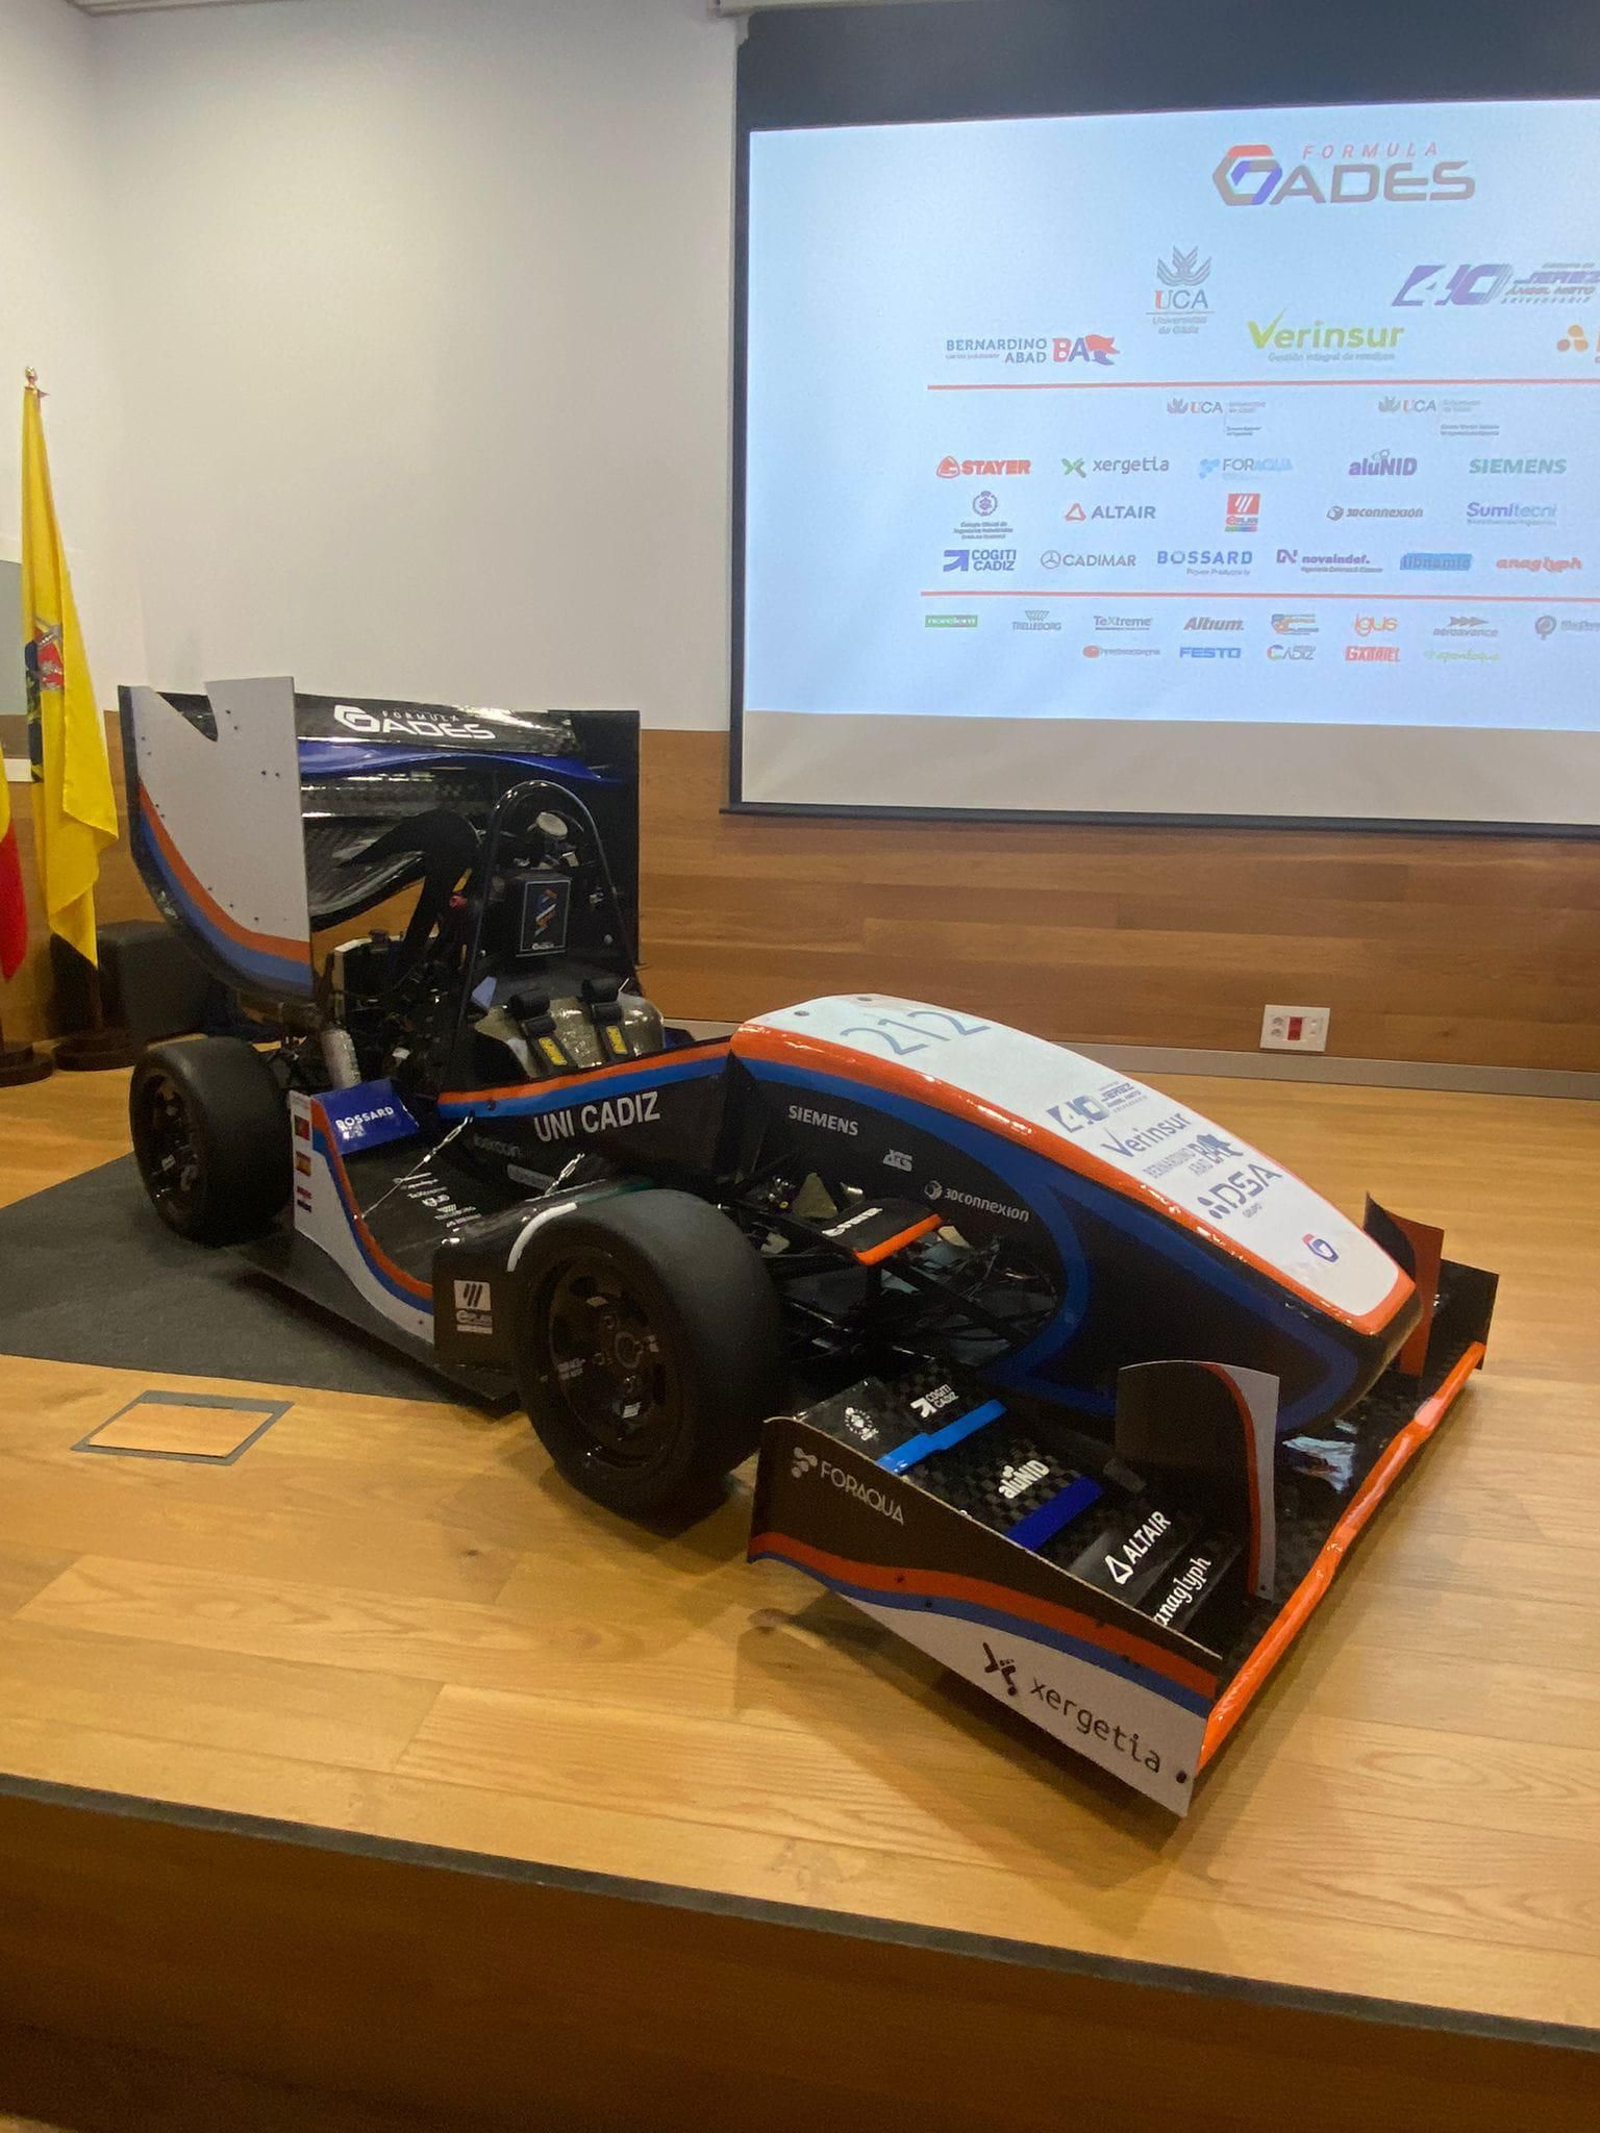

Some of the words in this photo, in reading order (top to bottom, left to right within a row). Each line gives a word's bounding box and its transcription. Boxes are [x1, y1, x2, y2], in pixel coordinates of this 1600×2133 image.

[1301, 141, 1439, 160] FORMULA
[1154, 289, 1209, 310] UCA
[1248, 308, 1404, 350] Verinsur
[946, 337, 1048, 351] BERNARDINO
[1004, 351, 1047, 364] ABAD
[960, 459, 1032, 475] STAYER
[1092, 455, 1170, 475] xergetia
[1348, 457, 1418, 476] aluNID
[1468, 458, 1567, 475] SIEMENS
[1091, 505, 1156, 520] ALTAIR
[971, 549, 1017, 560] COGITI
[1062, 553, 1136, 568] CADIMAR
[1157, 550, 1253, 565] BOSSARD
[973, 560, 1016, 572] CADIZ
[1354, 613, 1398, 637] igus
[1179, 646, 1242, 659] FESTO
[840, 1010, 991, 1056] 212
[335, 1106, 394, 1132] BOSSARD
[534, 1111, 574, 1142] UNI
[580, 1090, 662, 1134] CADIZ
[788, 1105, 859, 1136] SIEMENS
[1100, 1112, 1192, 1158] Verinsur
[999, 1460, 1050, 1499] aluNID
[821, 1461, 905, 1526] FORAQUA
[1122, 1510, 1171, 1564] ALTAIR
[1153, 1556, 1211, 1628] anaglyph
[1030, 1678, 1161, 1773] xergetia
